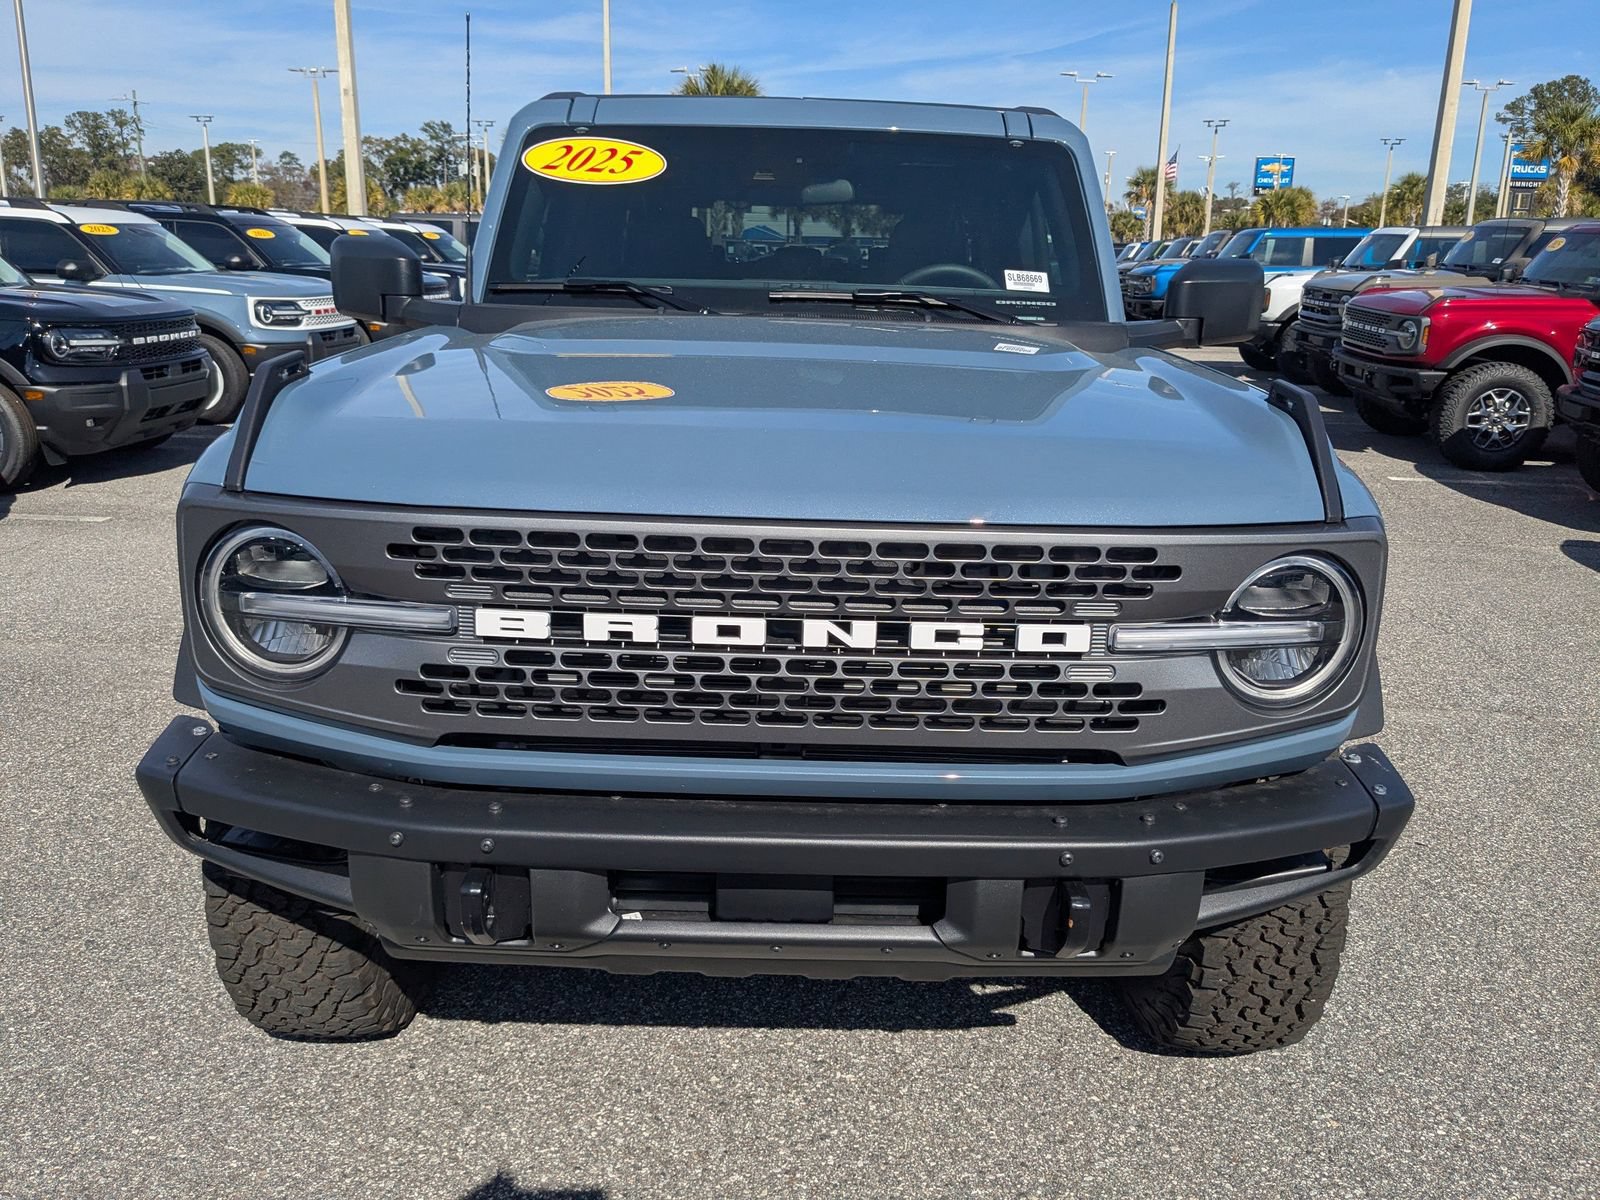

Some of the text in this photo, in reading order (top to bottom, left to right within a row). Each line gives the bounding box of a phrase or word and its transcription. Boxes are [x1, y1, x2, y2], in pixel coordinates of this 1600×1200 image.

[540, 144, 644, 174] 2025
[132, 329, 197, 345] BRONCO
[475, 608, 1092, 653] BRONCO
